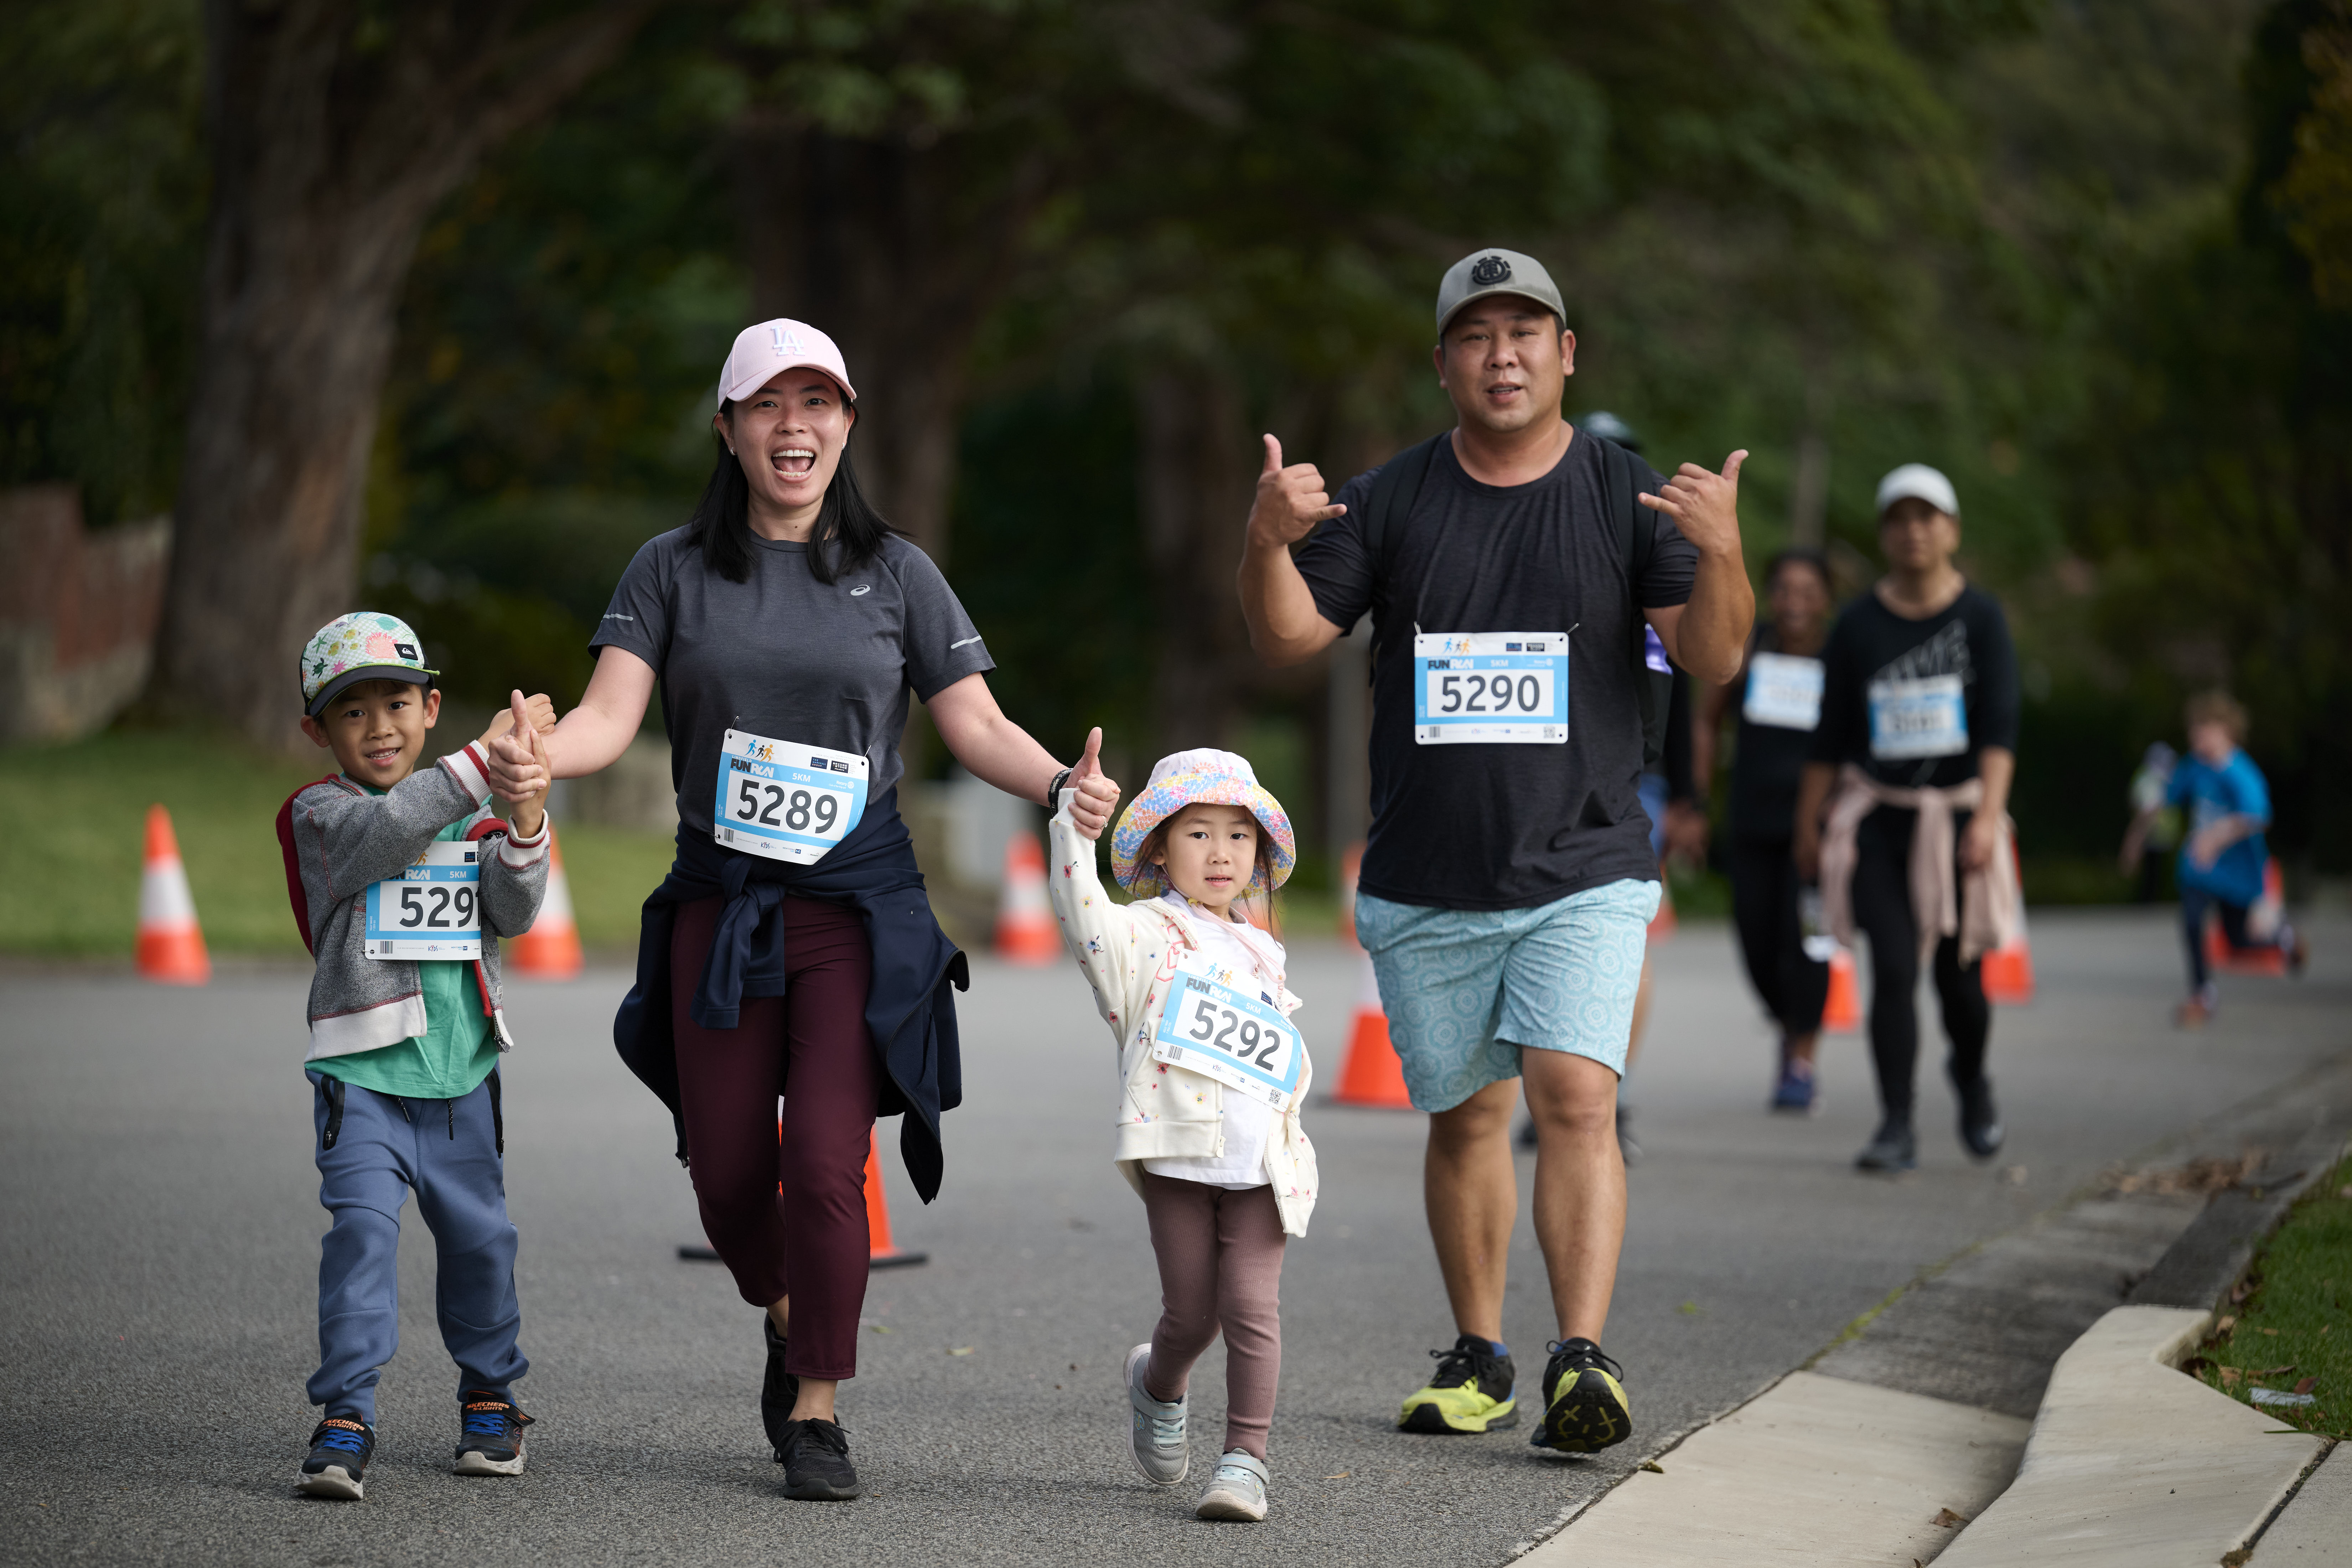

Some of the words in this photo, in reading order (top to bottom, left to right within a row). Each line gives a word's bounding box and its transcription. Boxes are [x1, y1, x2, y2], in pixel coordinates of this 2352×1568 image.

[771, 325, 805, 356] LA
[1428, 660, 1450, 669] FUN
[1441, 675, 1540, 712] 5290
[730, 758, 751, 772] FUN
[751, 763, 774, 778] RUN
[792, 773, 811, 782] 5KM
[737, 779, 838, 834] 5289
[406, 869, 430, 880] RUN
[399, 887, 480, 927] 5291
[1188, 974, 1212, 984] LINDFIELD
[1186, 977, 1211, 994] FUN
[1209, 985, 1232, 1003] RUN
[1245, 1002, 1261, 1015] 5KM
[1189, 999, 1280, 1072] 5292
[322, 1419, 365, 1430] SKECHERS
